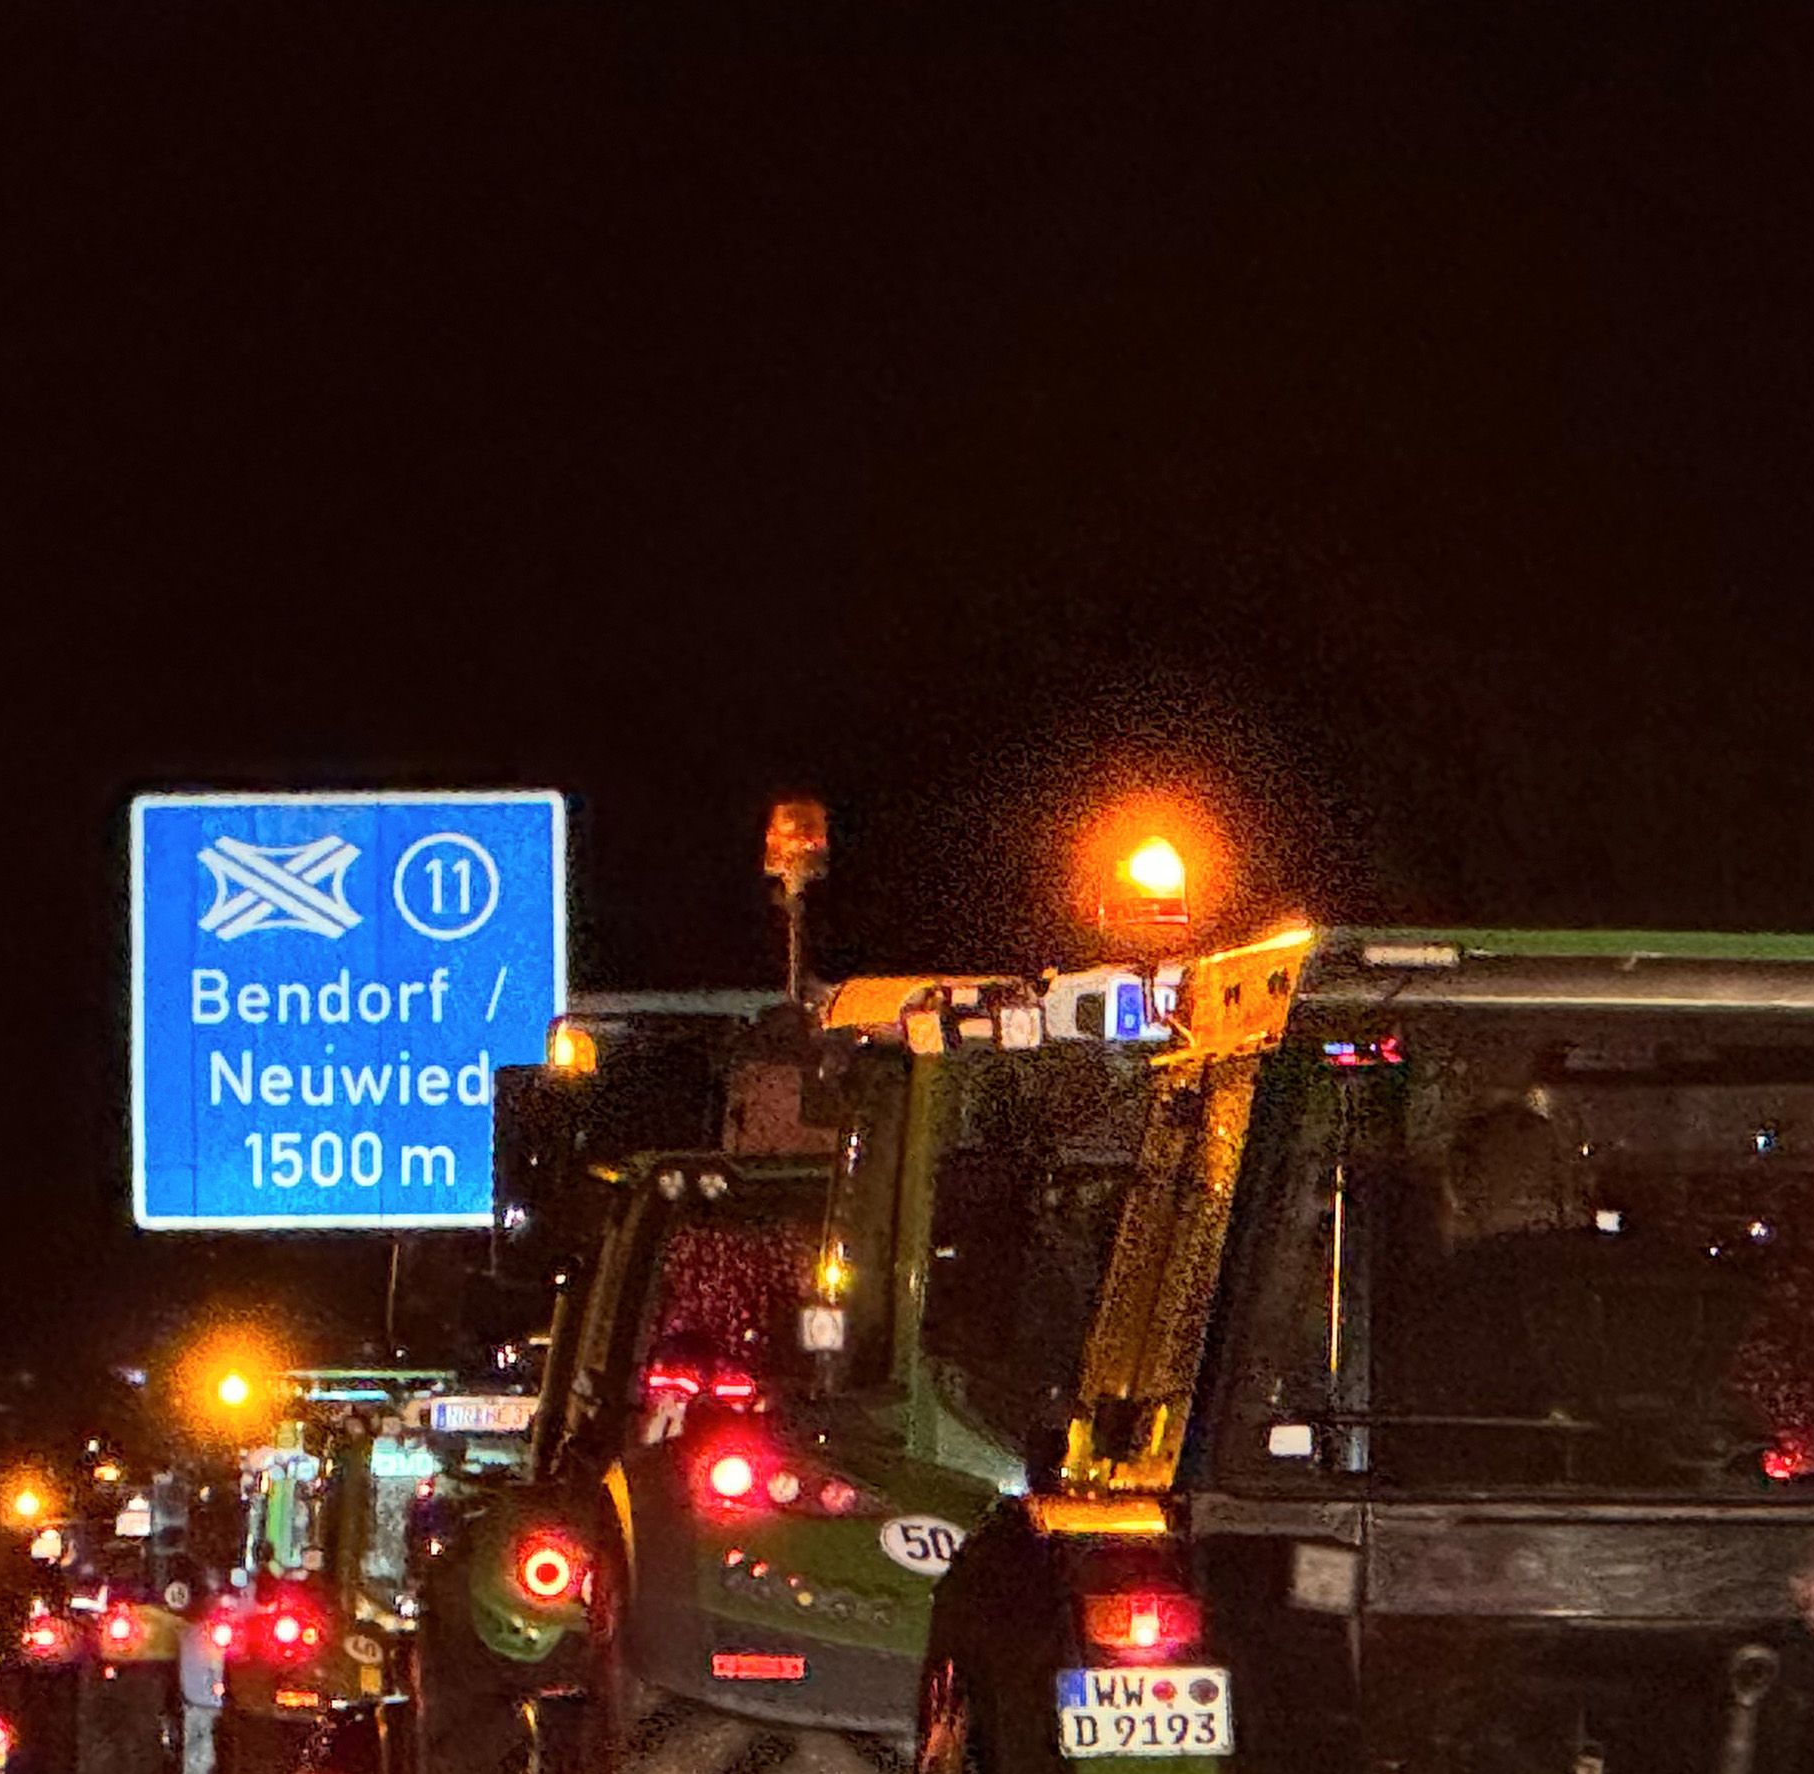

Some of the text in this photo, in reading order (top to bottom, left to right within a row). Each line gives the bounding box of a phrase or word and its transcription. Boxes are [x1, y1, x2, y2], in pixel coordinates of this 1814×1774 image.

[425, 858, 471, 915] 11
[191, 965, 508, 1024] Bendorf /
[210, 1043, 490, 1107] Neuwied
[244, 1131, 456, 1189] 1500 m
[899, 1523, 955, 1562] 50
[1094, 1674, 1145, 1707] WW
[1074, 1713, 1216, 1747] D 9193
